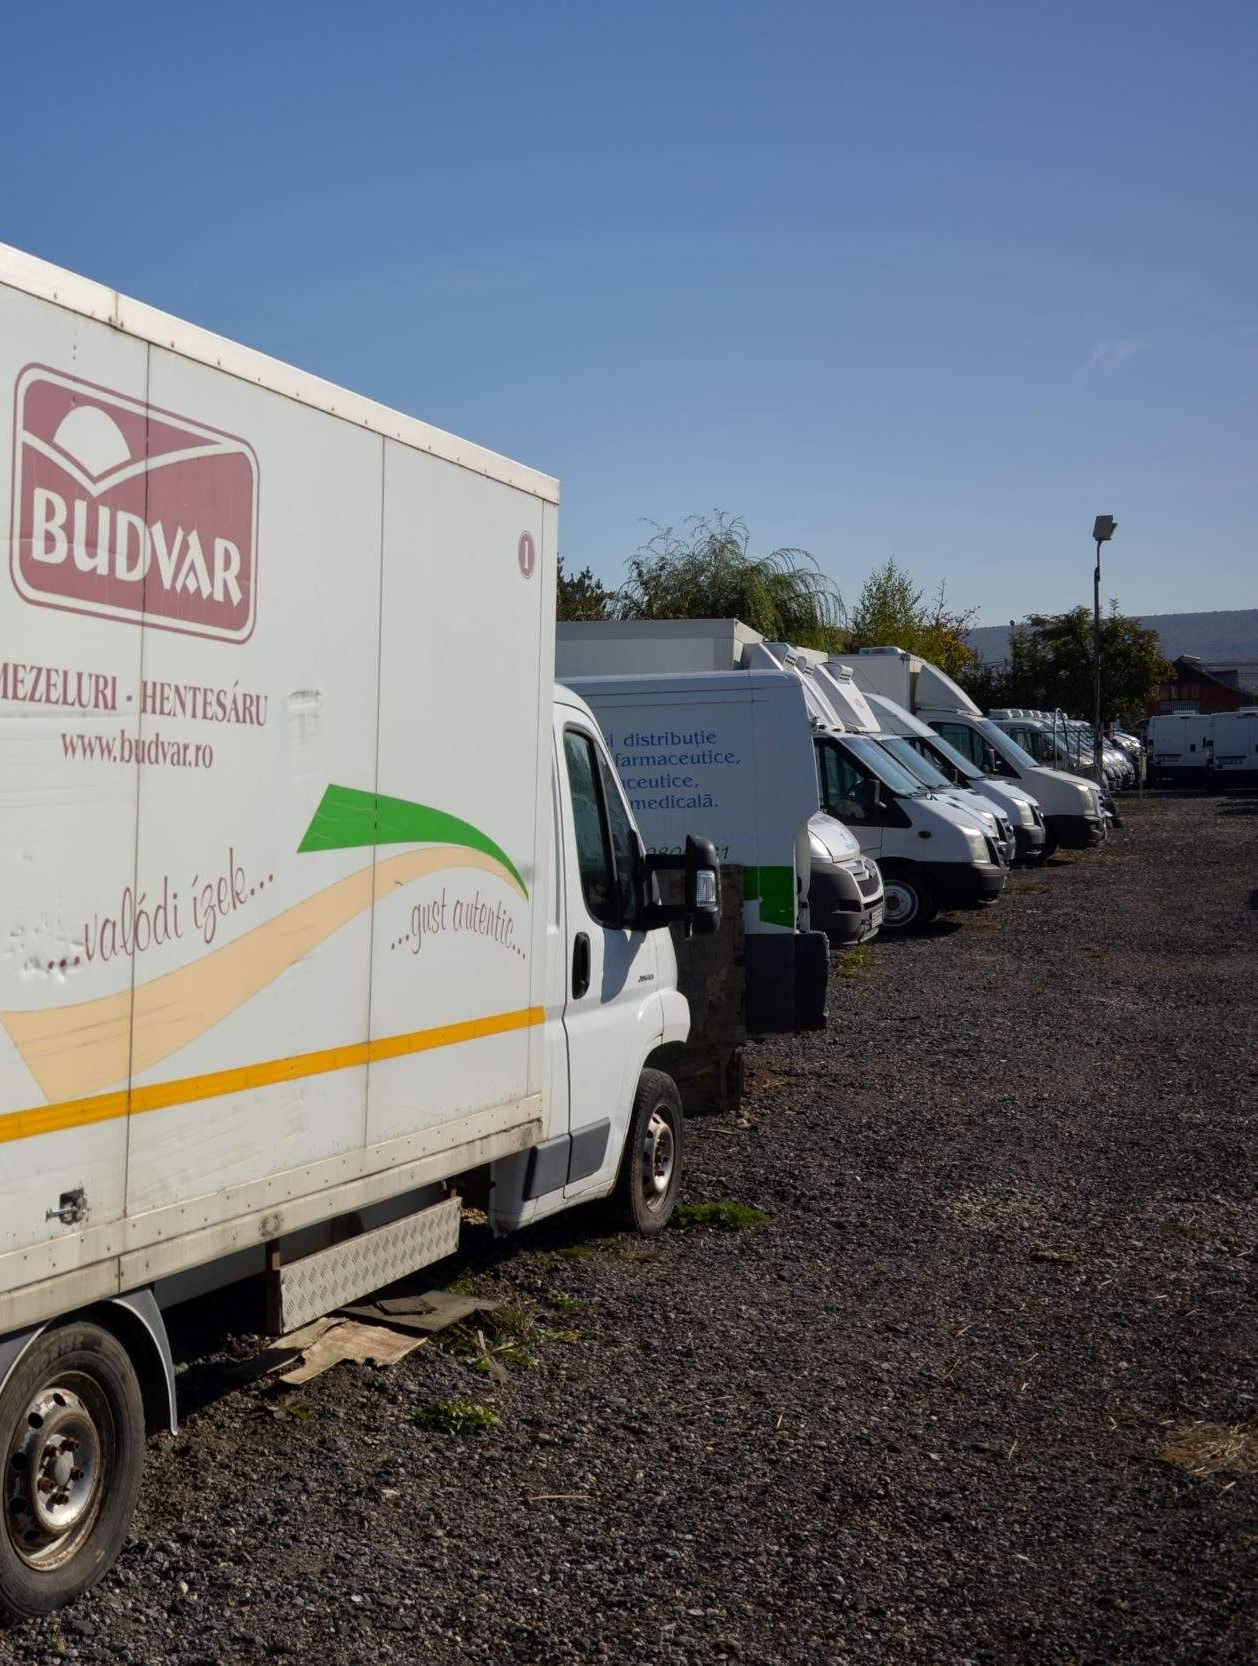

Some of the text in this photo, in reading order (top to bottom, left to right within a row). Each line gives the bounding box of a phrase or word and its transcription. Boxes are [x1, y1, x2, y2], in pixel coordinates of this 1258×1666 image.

[32, 487, 242, 607] BUDVAR
[141, 679, 270, 727] HENTESÁRU
[60, 729, 214, 768] www.budvar.ro
[615, 750, 741, 767] farmaceutice,
